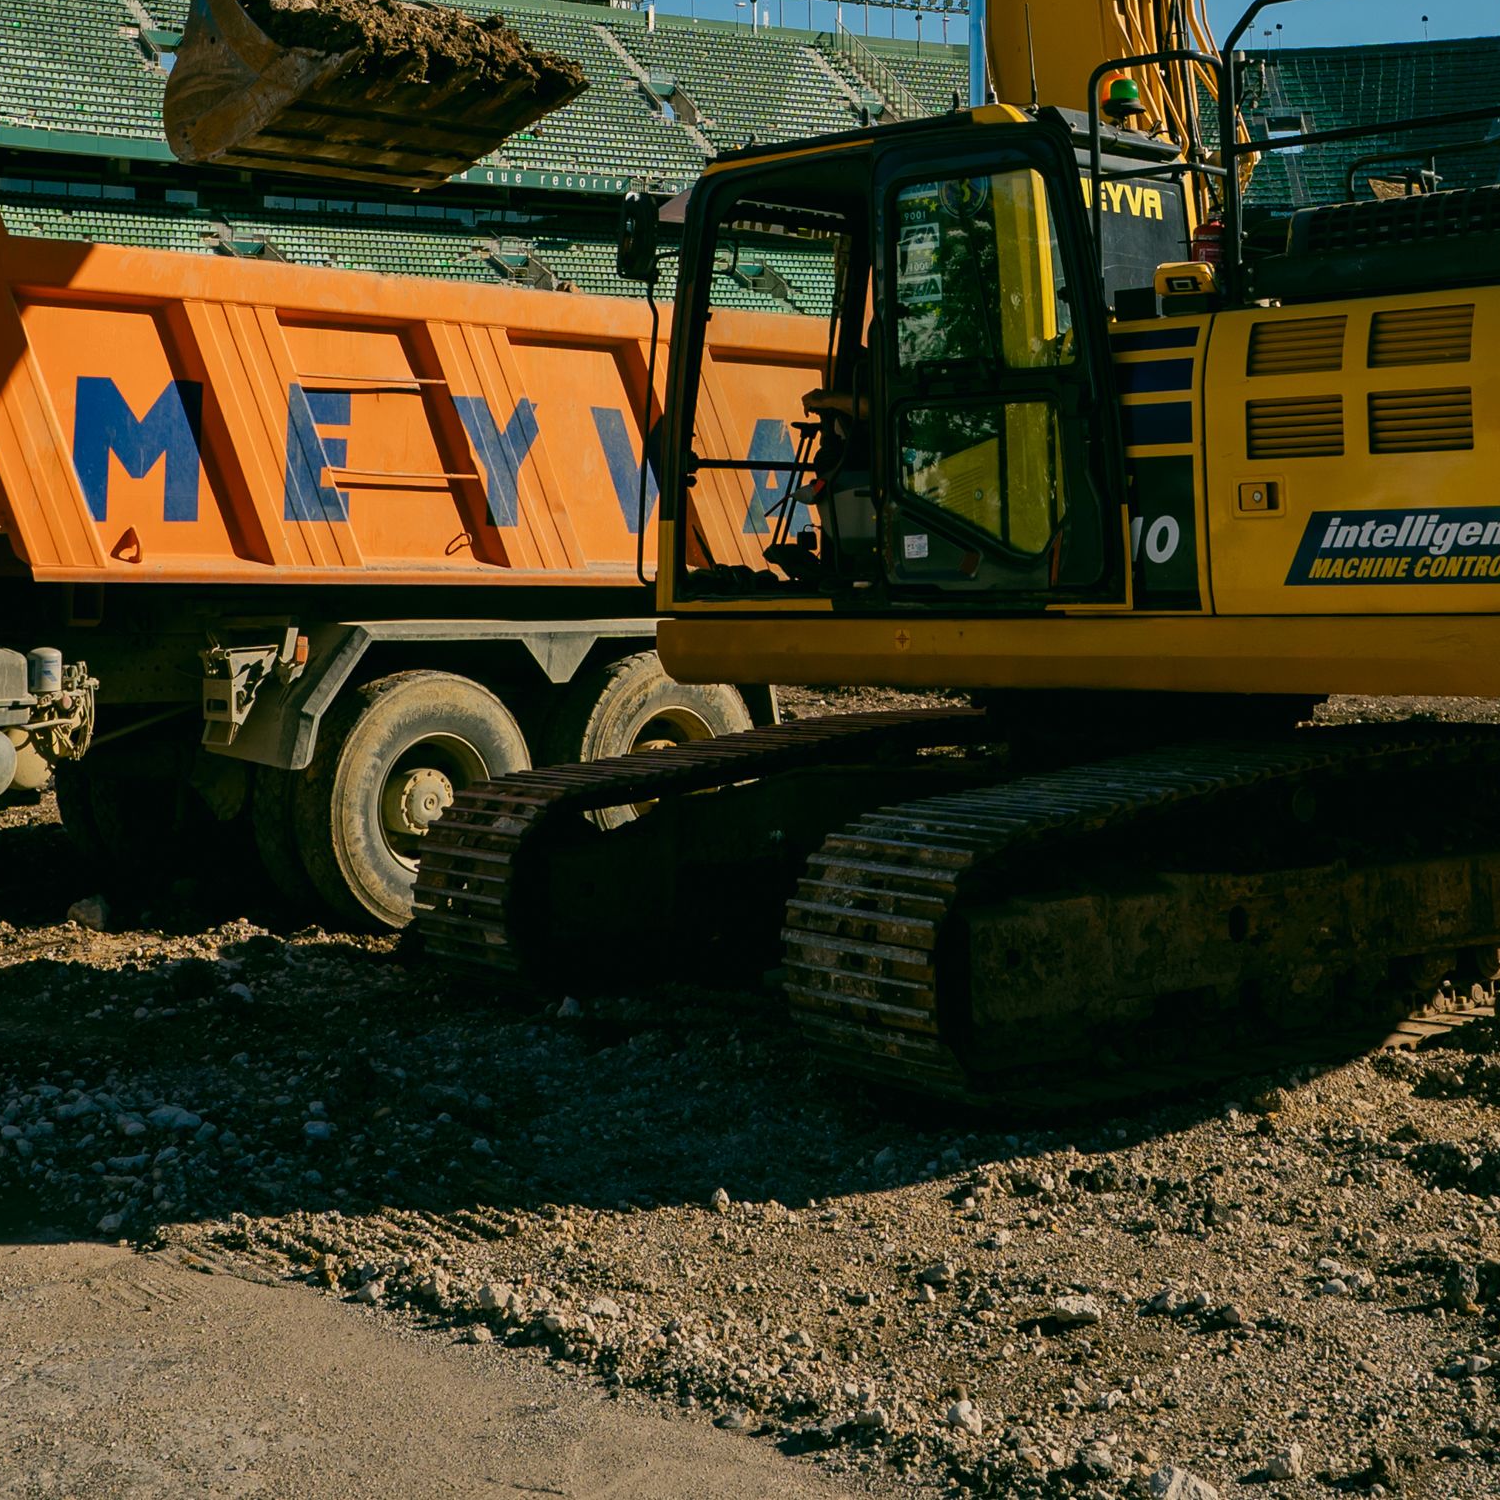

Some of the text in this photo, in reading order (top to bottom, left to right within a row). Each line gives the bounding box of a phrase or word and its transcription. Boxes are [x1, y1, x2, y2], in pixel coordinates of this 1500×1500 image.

[486, 170, 522, 184] que
[540, 173, 623, 191] recorre
[903, 210, 926, 221] 9001
[1308, 557, 1409, 579] MACHINE
